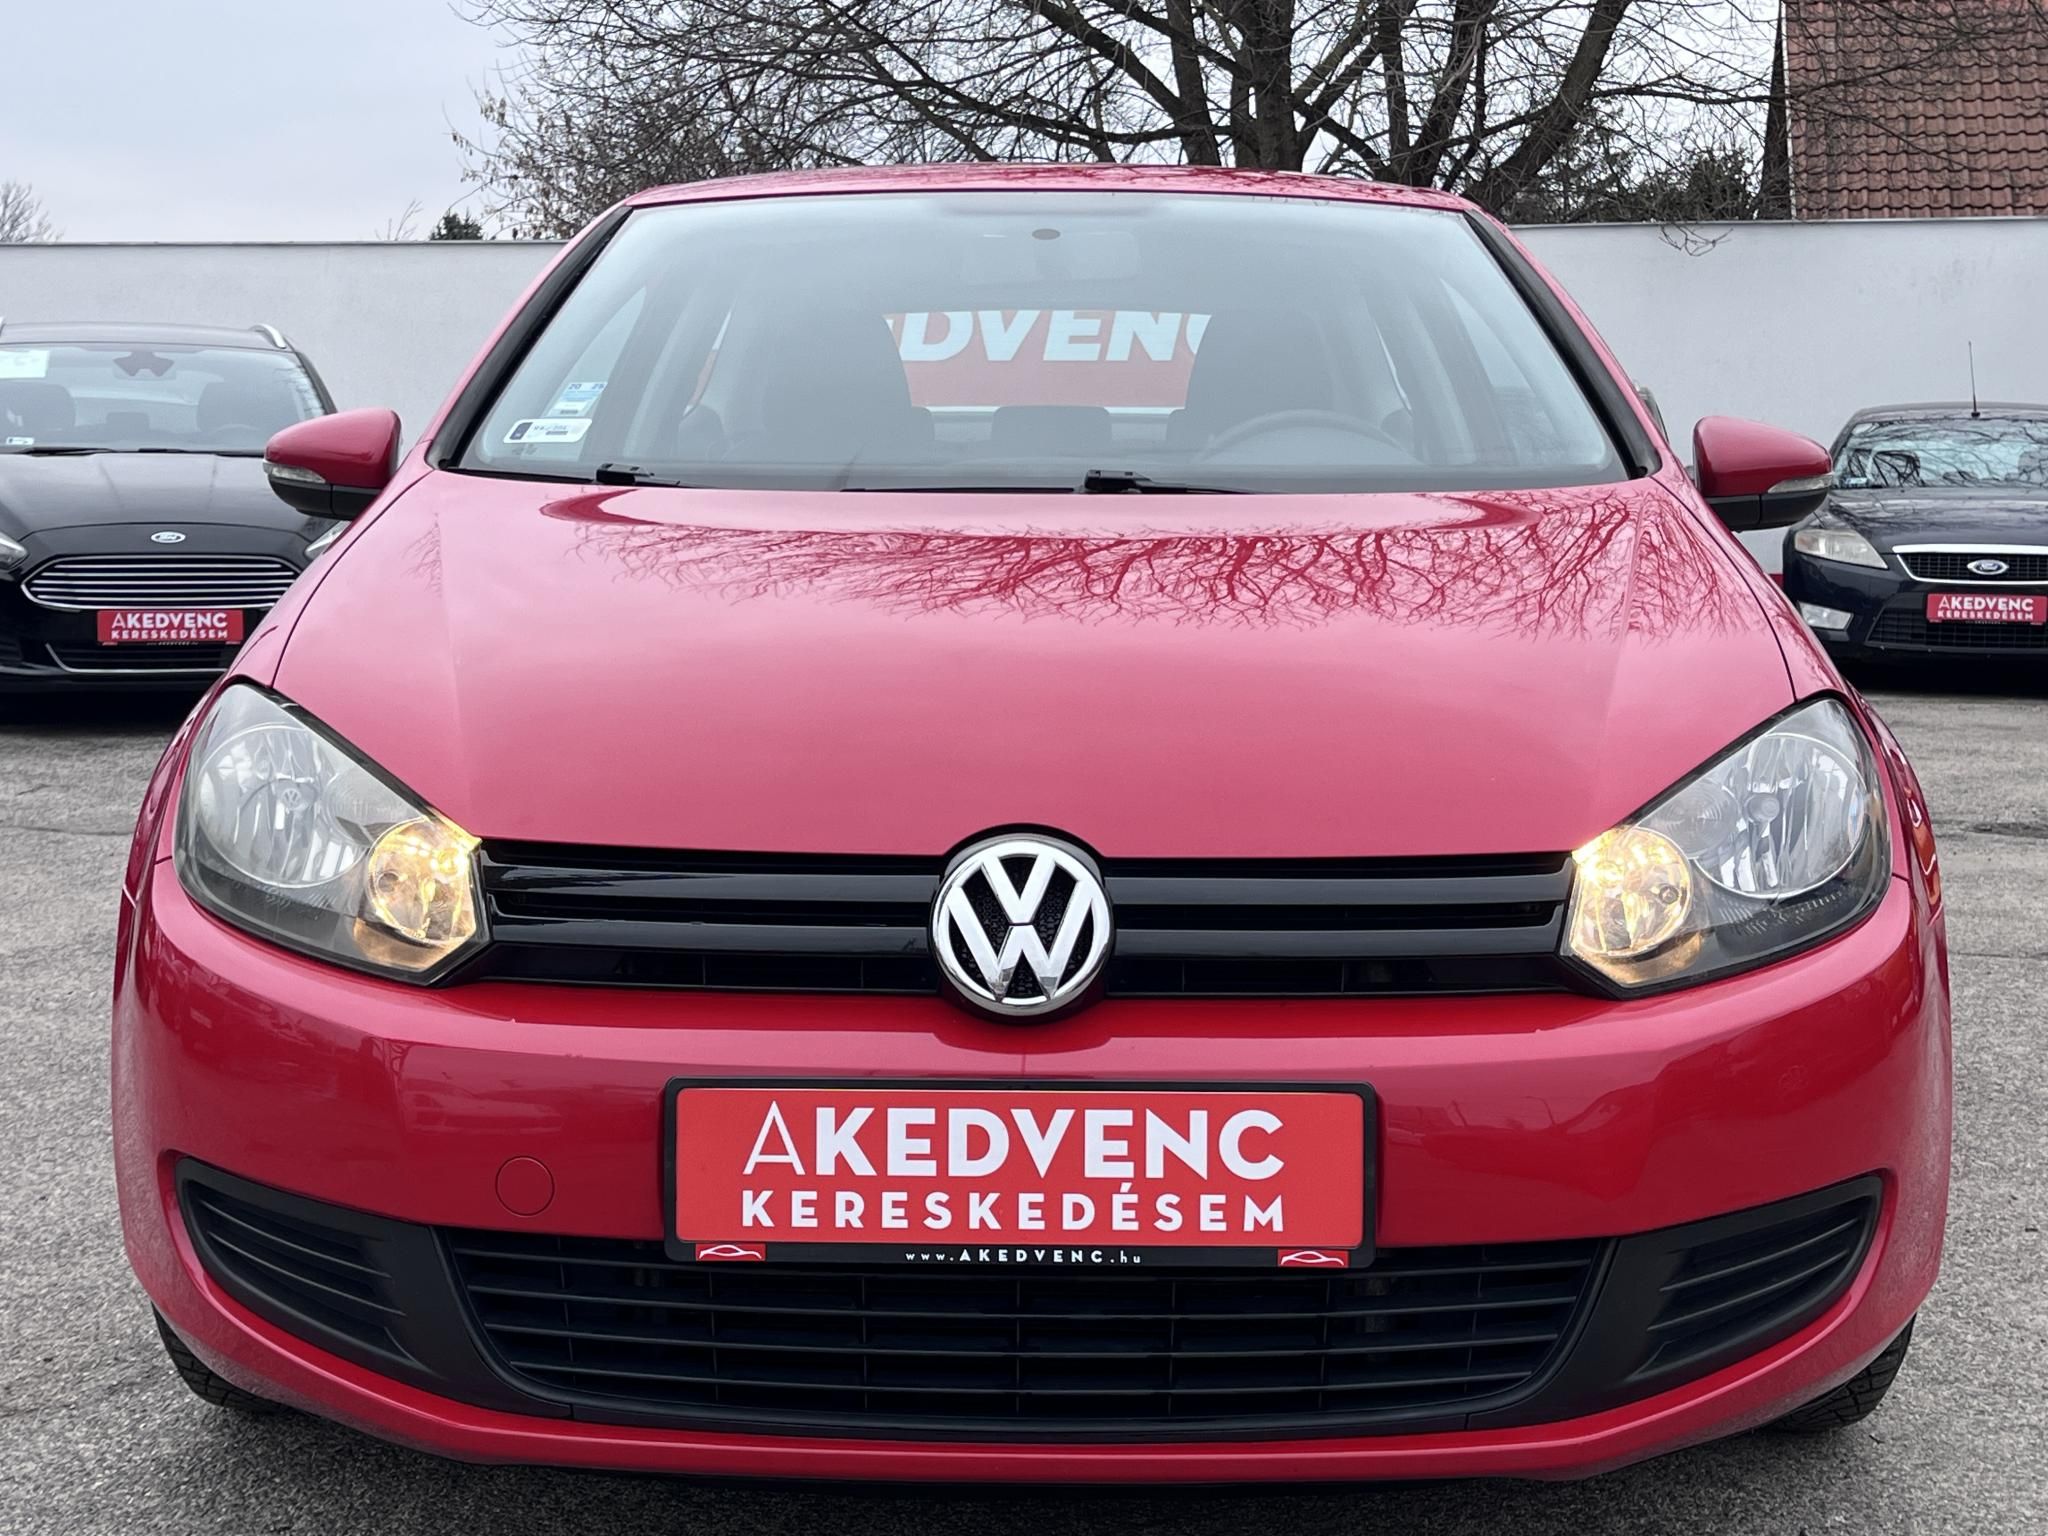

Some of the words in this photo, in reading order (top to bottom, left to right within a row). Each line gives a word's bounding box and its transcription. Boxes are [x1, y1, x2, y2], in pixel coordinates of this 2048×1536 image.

[885, 310, 1211, 361] DVEN
[1939, 595, 2034, 611] AKEDVENC
[111, 612, 228, 628] AKEDVENC
[111, 628, 228, 639] KERESKEDÉSEM
[743, 1100, 1285, 1181] AKEDVENC
[742, 1182, 1285, 1233] KERESKEDÉSEM
[905, 1248, 1142, 1264] www.AKEDVENC.hu
